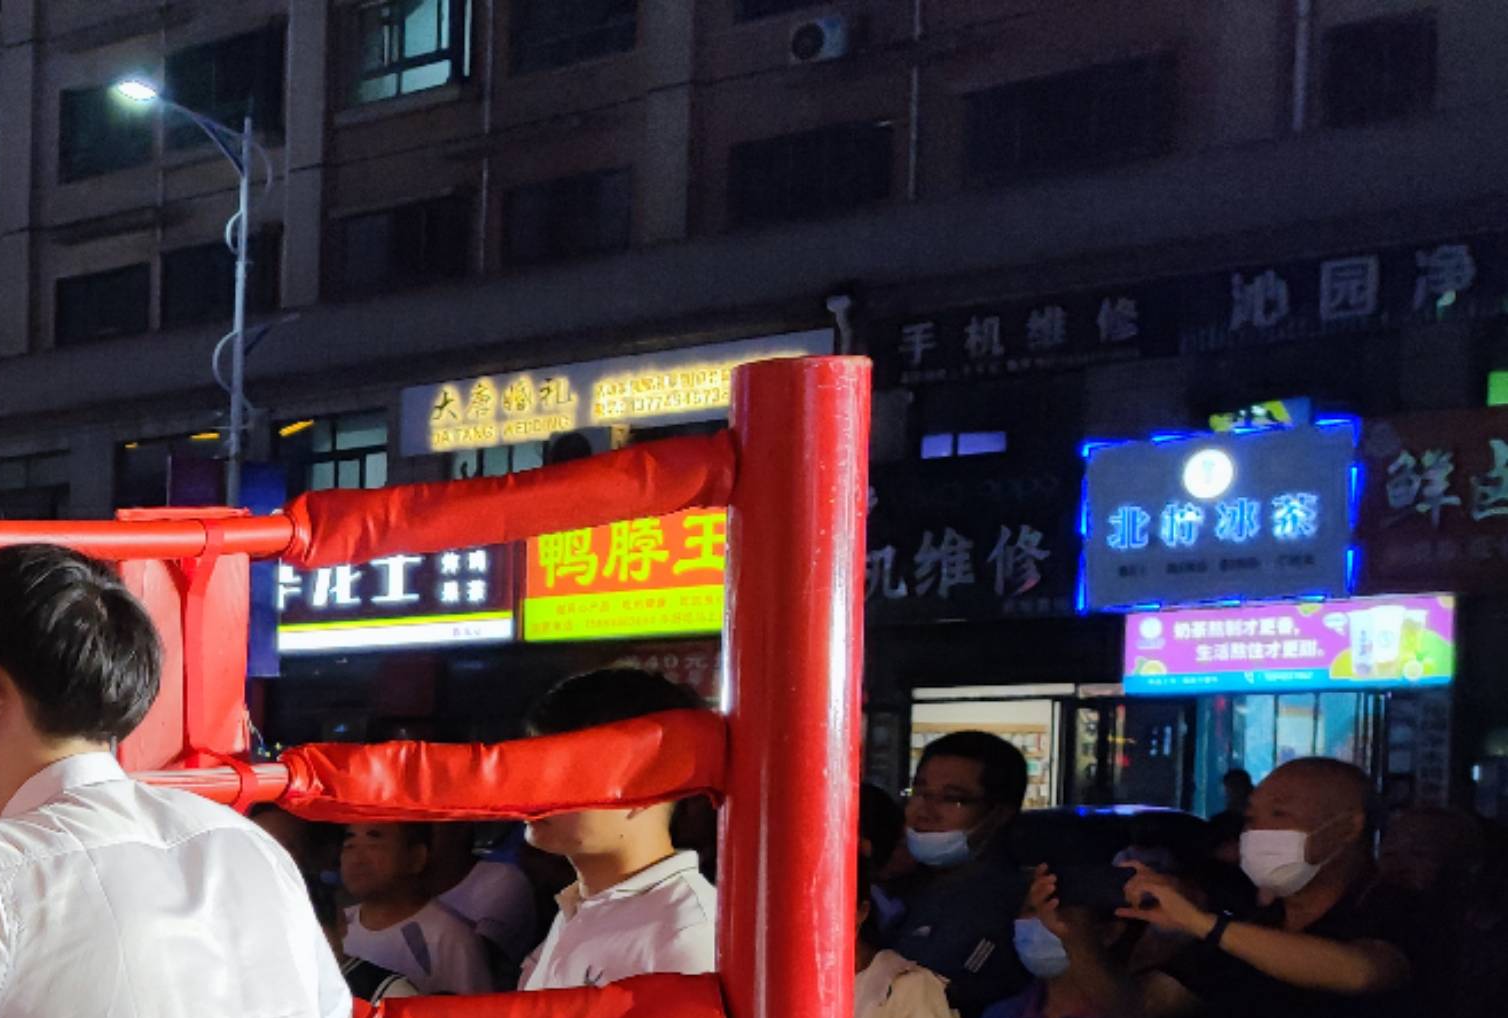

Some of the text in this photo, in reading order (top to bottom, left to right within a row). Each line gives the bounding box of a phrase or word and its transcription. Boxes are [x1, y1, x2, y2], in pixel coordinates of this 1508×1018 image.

[900, 297, 1139, 366] 手机维修
[432, 378, 573, 421] 大唐婚礼
[538, 512, 726, 588] 鸭脖王
[1106, 492, 1320, 550] 北柠冰茶
